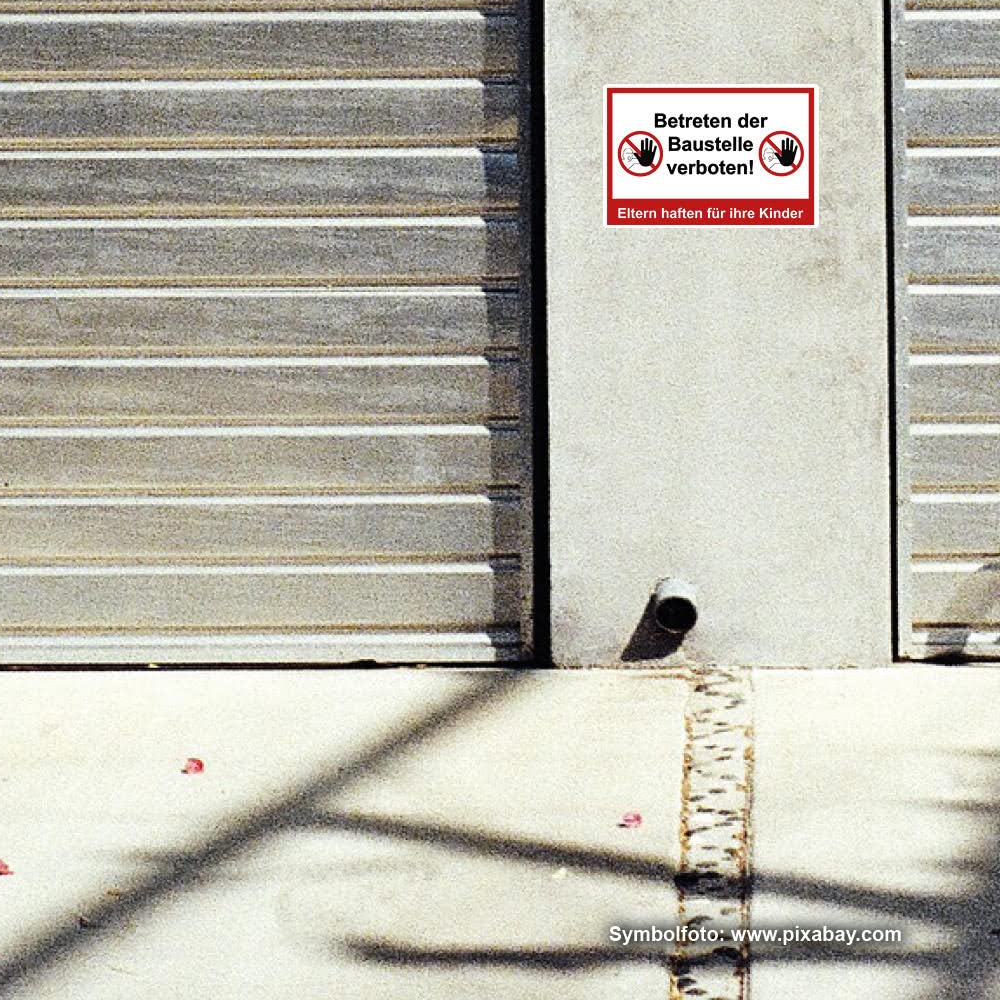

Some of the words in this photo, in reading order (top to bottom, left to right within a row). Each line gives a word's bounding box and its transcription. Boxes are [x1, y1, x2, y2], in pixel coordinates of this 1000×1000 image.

[654, 113, 732, 129] Betreten
[737, 113, 768, 129] der
[668, 136, 754, 152] Baustelle
[666, 159, 754, 175] verboten!
[617, 207, 657, 219] Eltern
[661, 207, 703, 219] haften
[706, 207, 726, 219] für
[729, 207, 755, 219] ihre
[759, 207, 804, 219] Kinder
